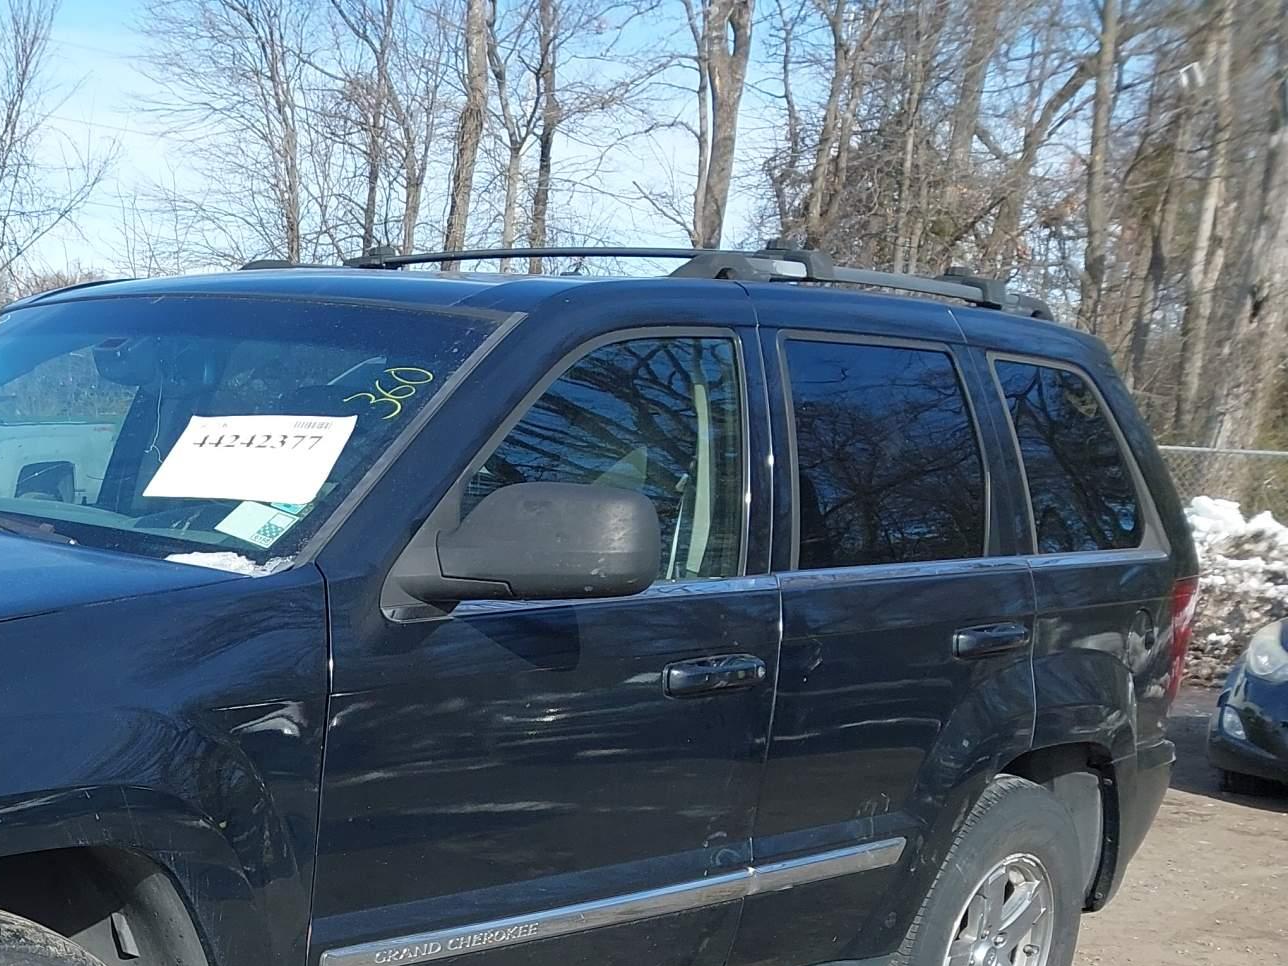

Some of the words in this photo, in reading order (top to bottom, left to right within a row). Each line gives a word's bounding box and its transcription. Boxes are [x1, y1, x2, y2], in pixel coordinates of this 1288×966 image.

[343, 368, 433, 420] 360
[192, 434, 324, 450] 44242377
[375, 943, 442, 964] GRAND
[447, 922, 539, 951] CHEROKEE
